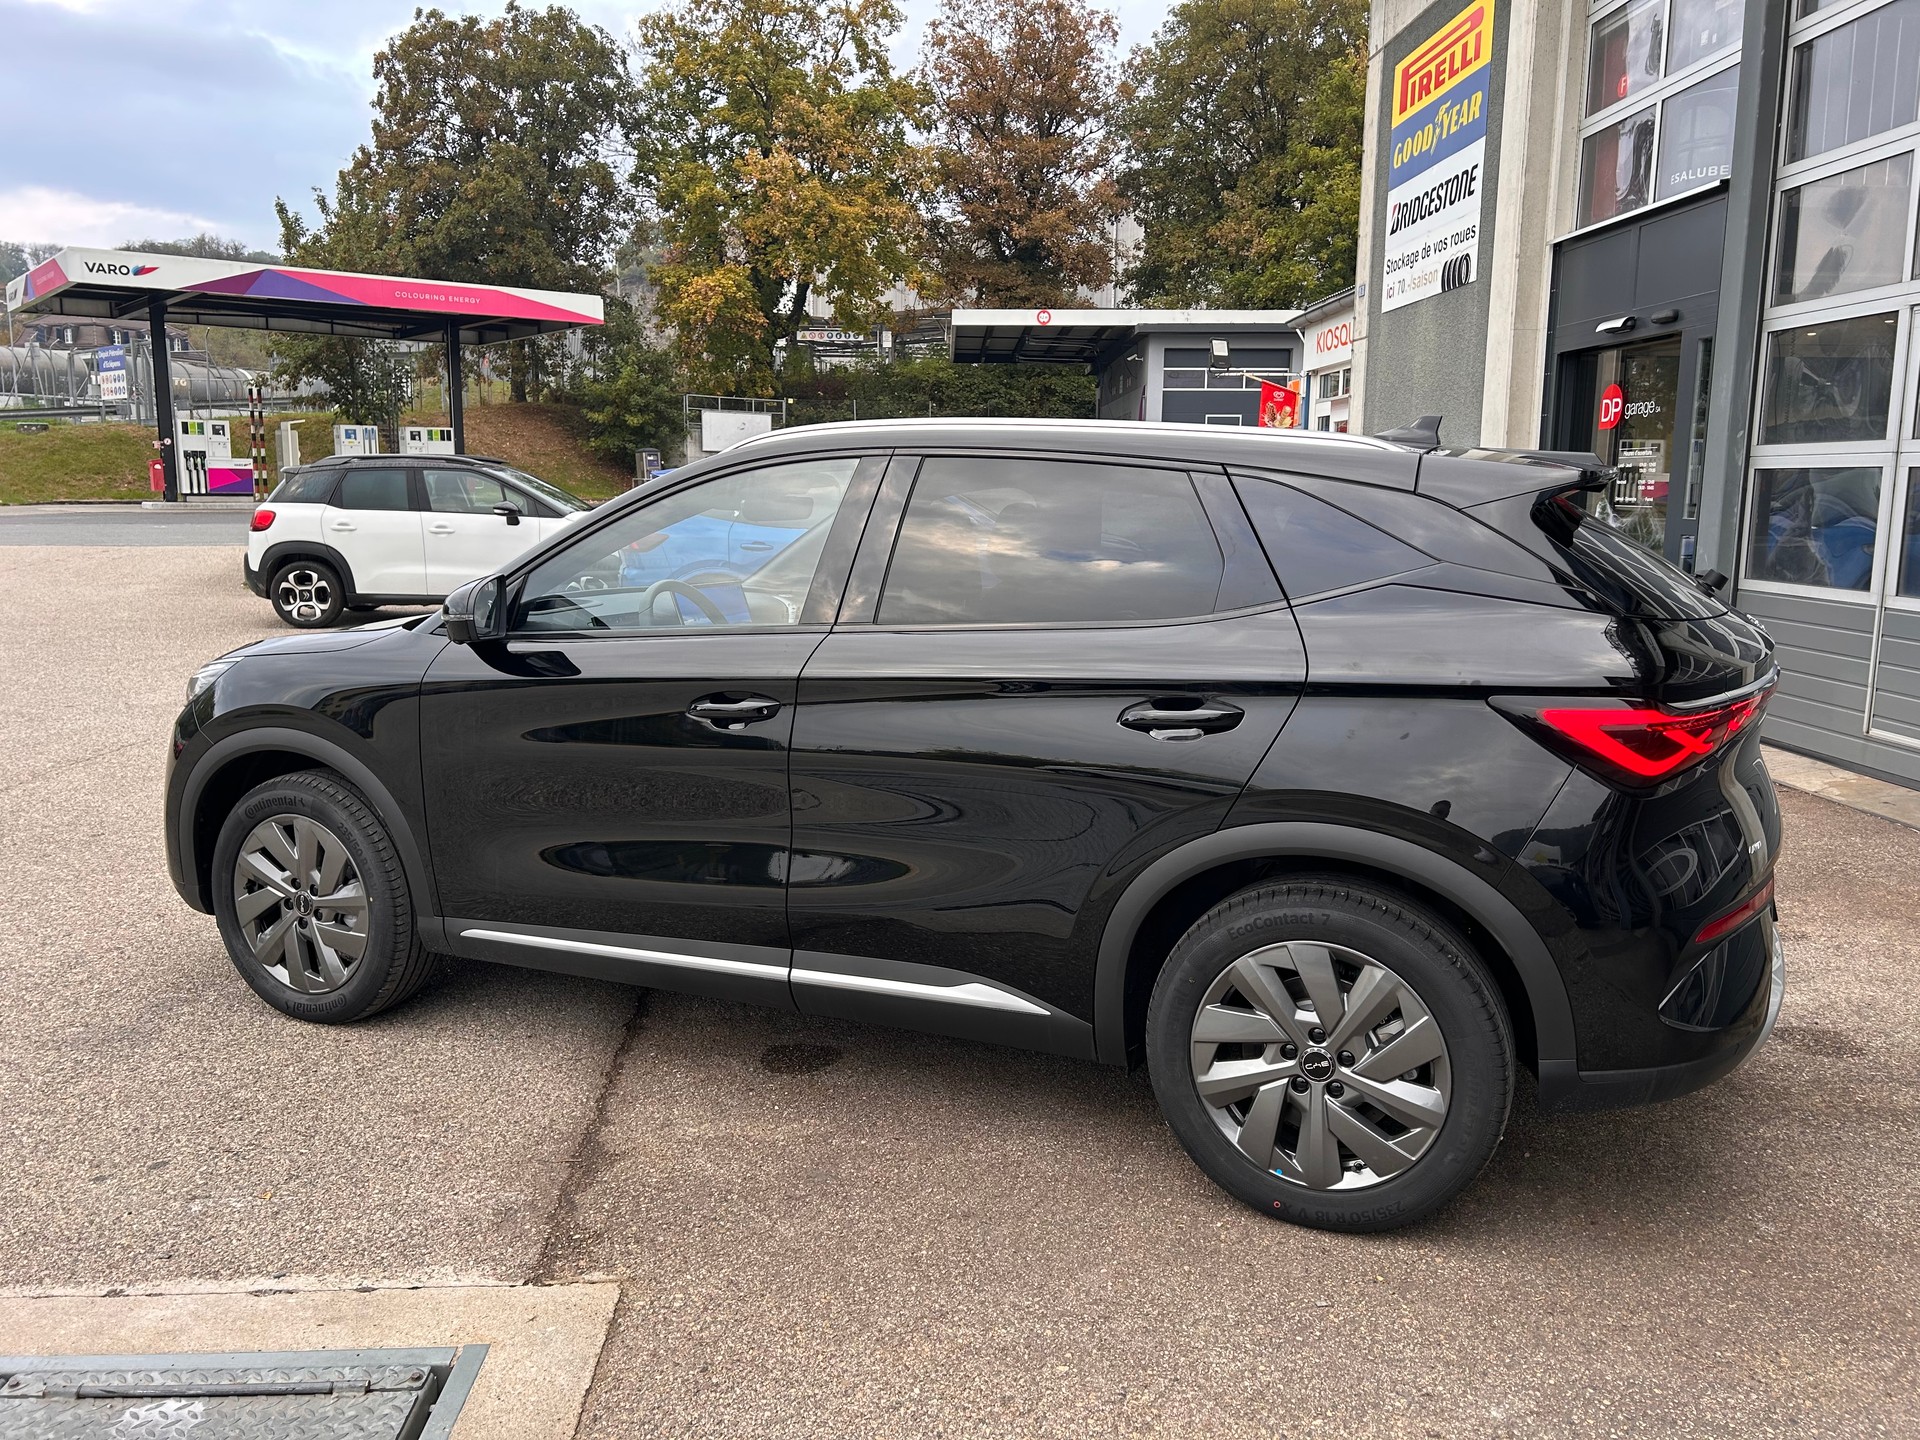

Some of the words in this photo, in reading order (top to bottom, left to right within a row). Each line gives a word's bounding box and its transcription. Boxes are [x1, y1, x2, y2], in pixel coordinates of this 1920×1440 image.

[1399, 6, 1484, 116] PIRELLI
[1390, 163, 1478, 236] BRIDGESTONE
[1386, 250, 1419, 275] Stockage
[1421, 242, 1431, 260] de
[1433, 236, 1448, 255] vos
[1450, 224, 1477, 248] roues
[84, 261, 130, 276] VARO
[394, 290, 446, 301] COLOURING
[448, 296, 481, 304] ENERGY
[1386, 281, 1395, 300] ici
[1601, 398, 1622, 423] DP
[1624, 401, 1655, 419] garage
[245, 795, 298, 819] Continental
[337, 822, 364, 857] 235/50
[1227, 912, 1314, 943] EcoContact
[1321, 912, 1331, 926] 7
[292, 993, 347, 1015] Continental
[1315, 1210, 1332, 1223] 18
[1334, 1210, 1346, 1224] R
[1349, 1200, 1406, 1224] 235/50
